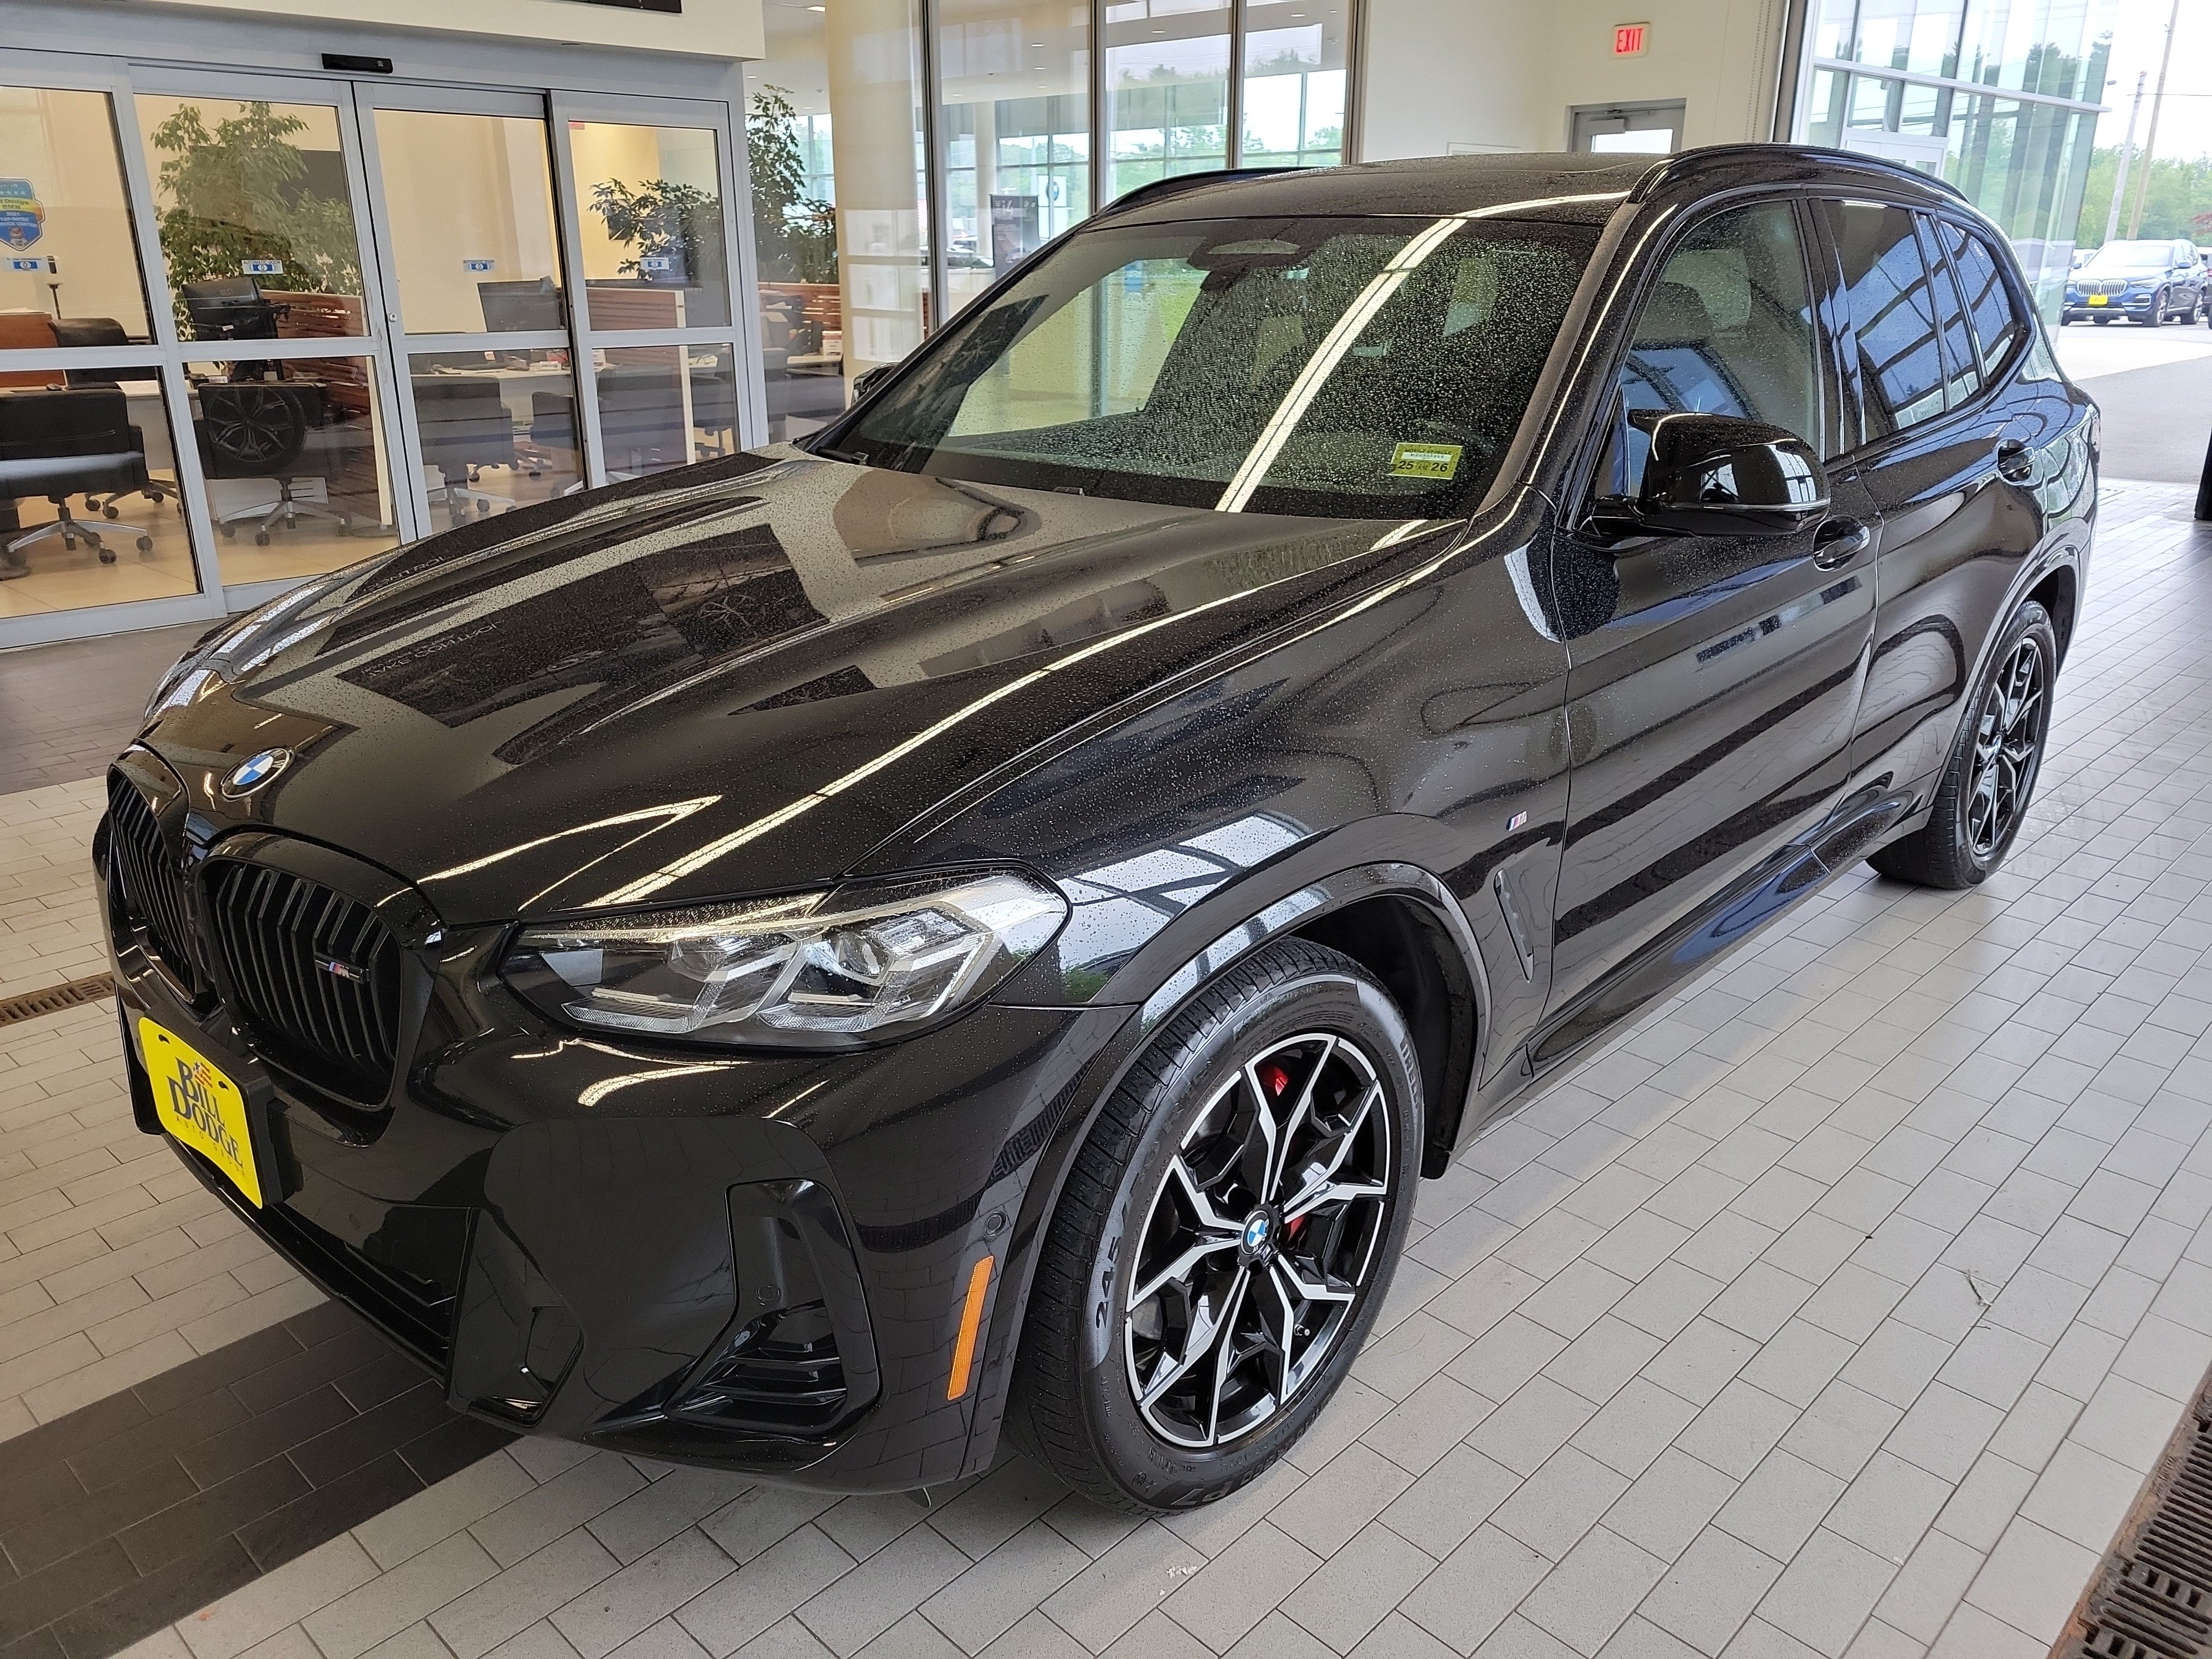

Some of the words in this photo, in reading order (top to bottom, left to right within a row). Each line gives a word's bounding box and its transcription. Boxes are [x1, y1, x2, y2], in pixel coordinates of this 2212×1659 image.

[1616, 27, 1643, 52] EXIT
[1398, 460, 1414, 470] 25
[1430, 462, 1448, 472] 26
[166, 1075, 243, 1169] DODGE
